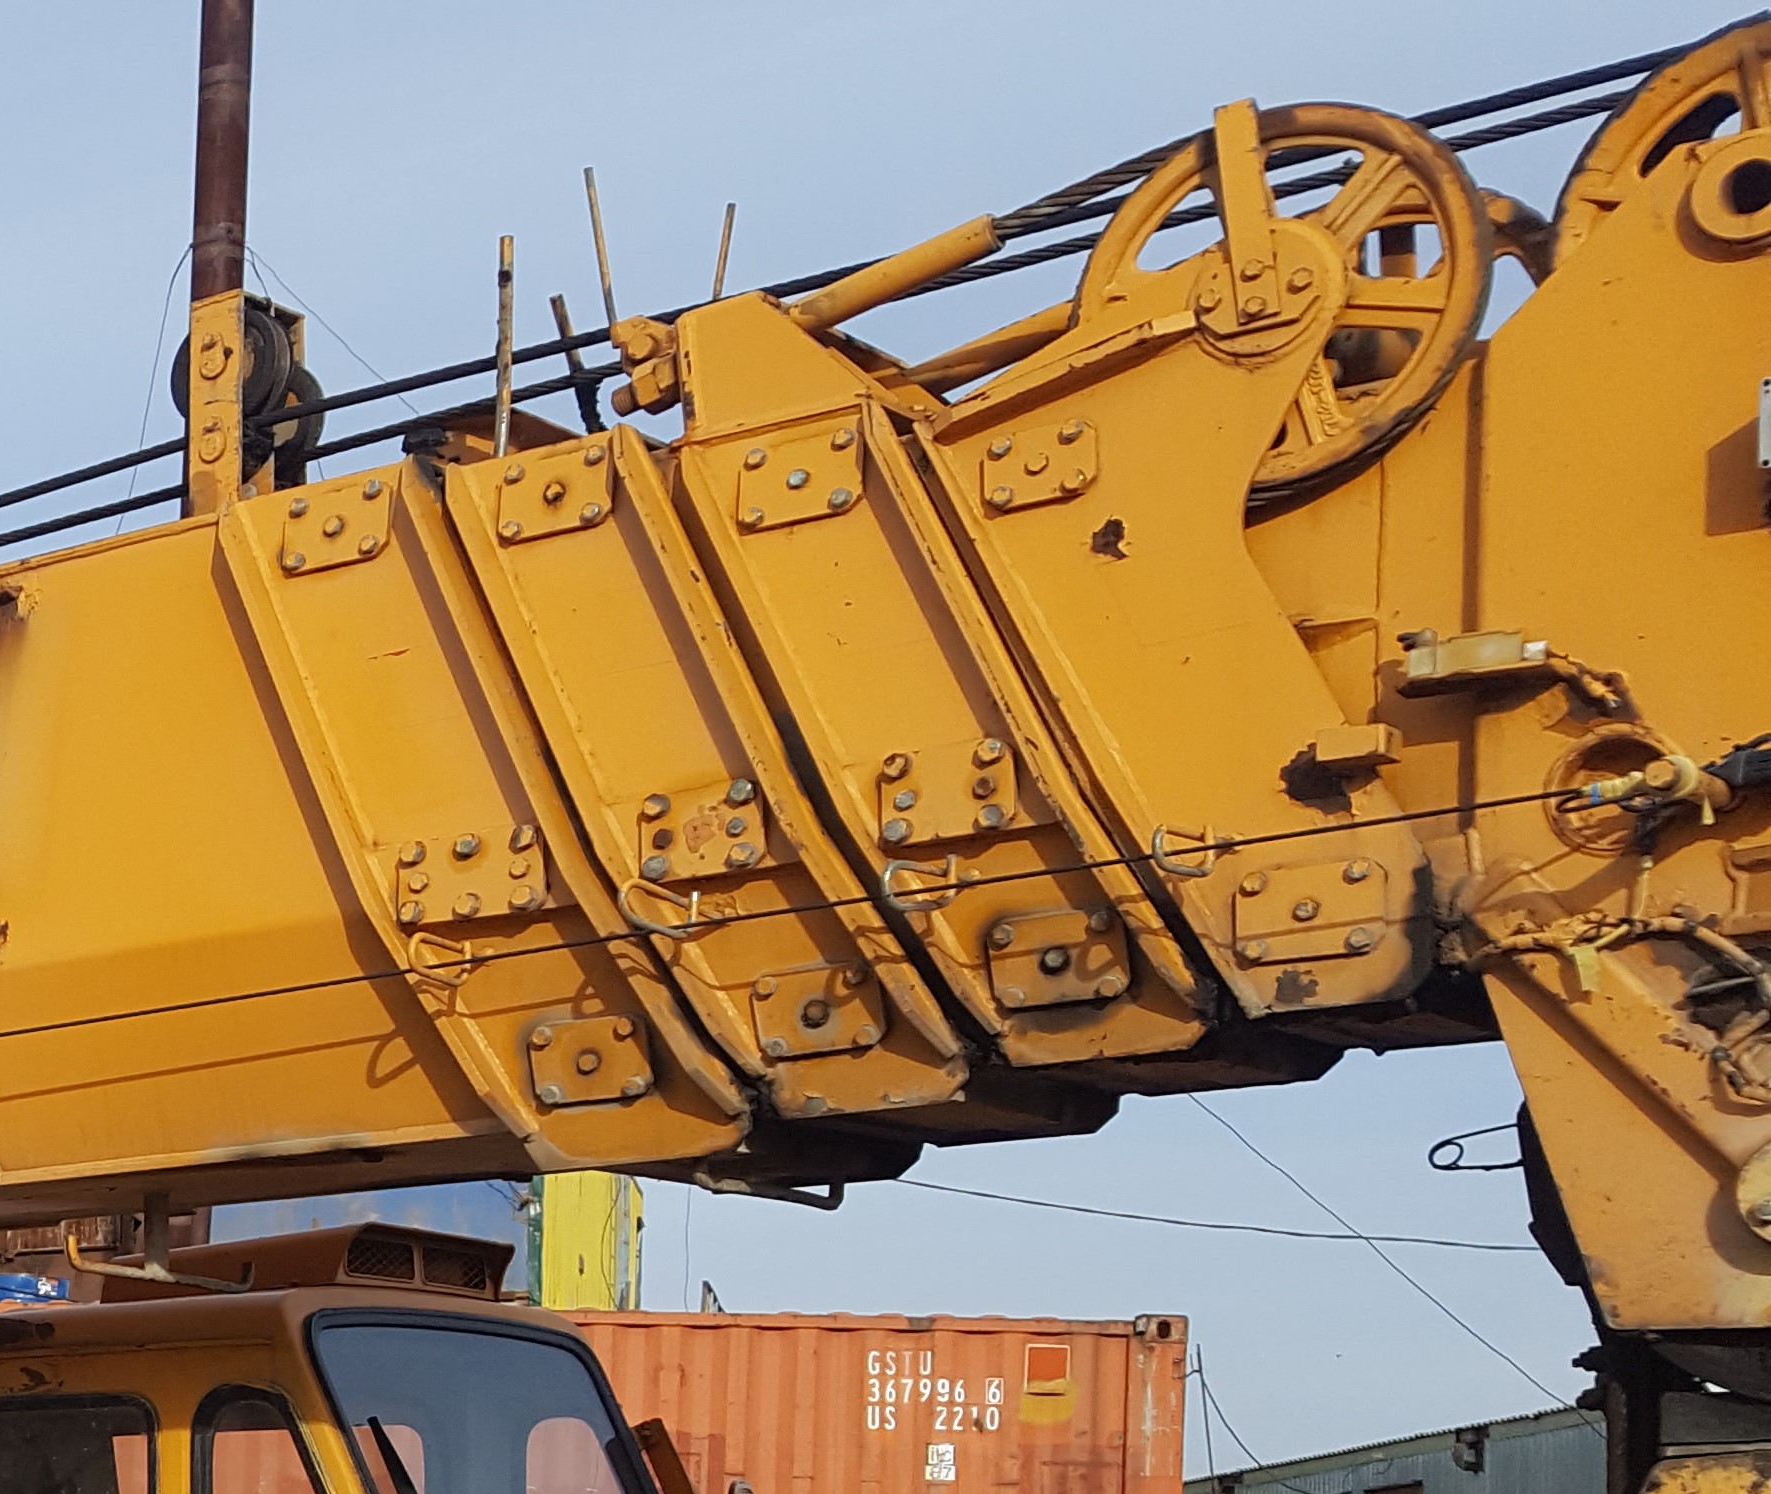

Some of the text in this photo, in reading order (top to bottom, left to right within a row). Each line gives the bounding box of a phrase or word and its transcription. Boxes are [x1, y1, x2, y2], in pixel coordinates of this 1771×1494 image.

[867, 1350, 932, 1376] GSTU
[867, 1378, 1001, 1403] 367996 6
[866, 1405, 1000, 1431] US 2210
